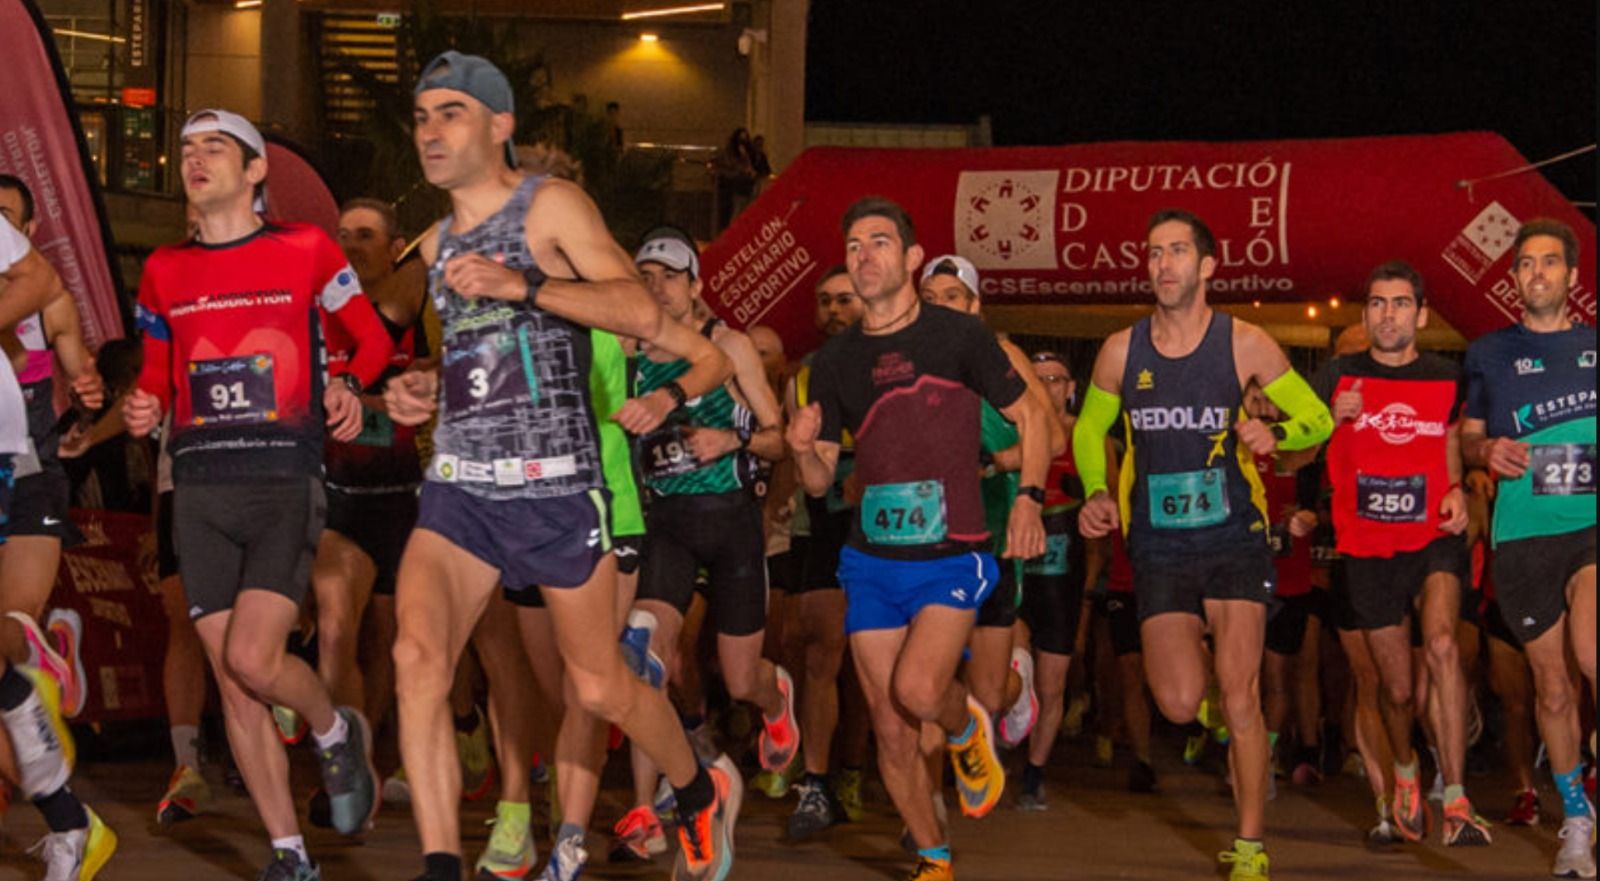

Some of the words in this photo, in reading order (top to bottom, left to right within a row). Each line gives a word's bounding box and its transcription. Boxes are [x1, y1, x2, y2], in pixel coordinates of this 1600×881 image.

[1063, 156, 1277, 193] DIPUTACIÓ
[1061, 202, 1087, 232] D
[1250, 197, 1274, 228] E
[1062, 230, 1274, 270] CASLÓ
[720, 229, 796, 309] ESCENARIO
[733, 246, 811, 325] DEPORTIVO
[209, 381, 251, 409] 91
[467, 367, 490, 398] 3
[1131, 406, 1225, 431] REDOLAT
[1544, 463, 1592, 484] 273
[874, 505, 927, 530] 474
[1162, 491, 1211, 516] 674
[1368, 493, 1415, 513] 250
